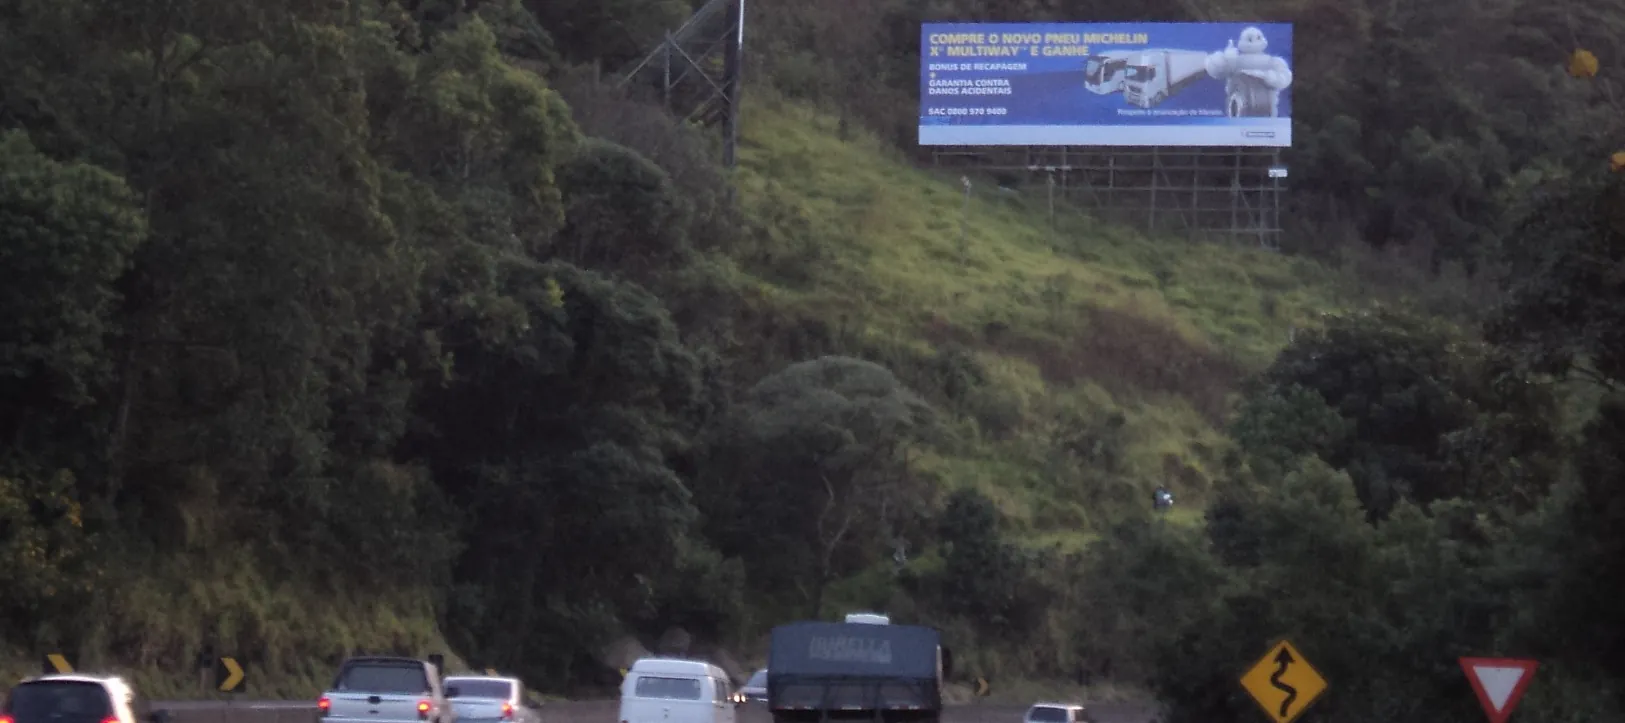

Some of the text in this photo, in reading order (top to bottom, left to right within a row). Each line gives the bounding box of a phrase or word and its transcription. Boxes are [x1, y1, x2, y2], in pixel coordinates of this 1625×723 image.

[930, 33, 1148, 44] COMPRE O NOVO PNEU MICHELIN
[1031, 46, 1038, 56] E
[1043, 46, 1090, 56] GANHE
[929, 63, 1027, 71] BONUS DE RECAPAGEM
[929, 79, 1010, 87] GARANTIA CONTRA
[929, 87, 1011, 95] DANOS ACIDENTAIS
